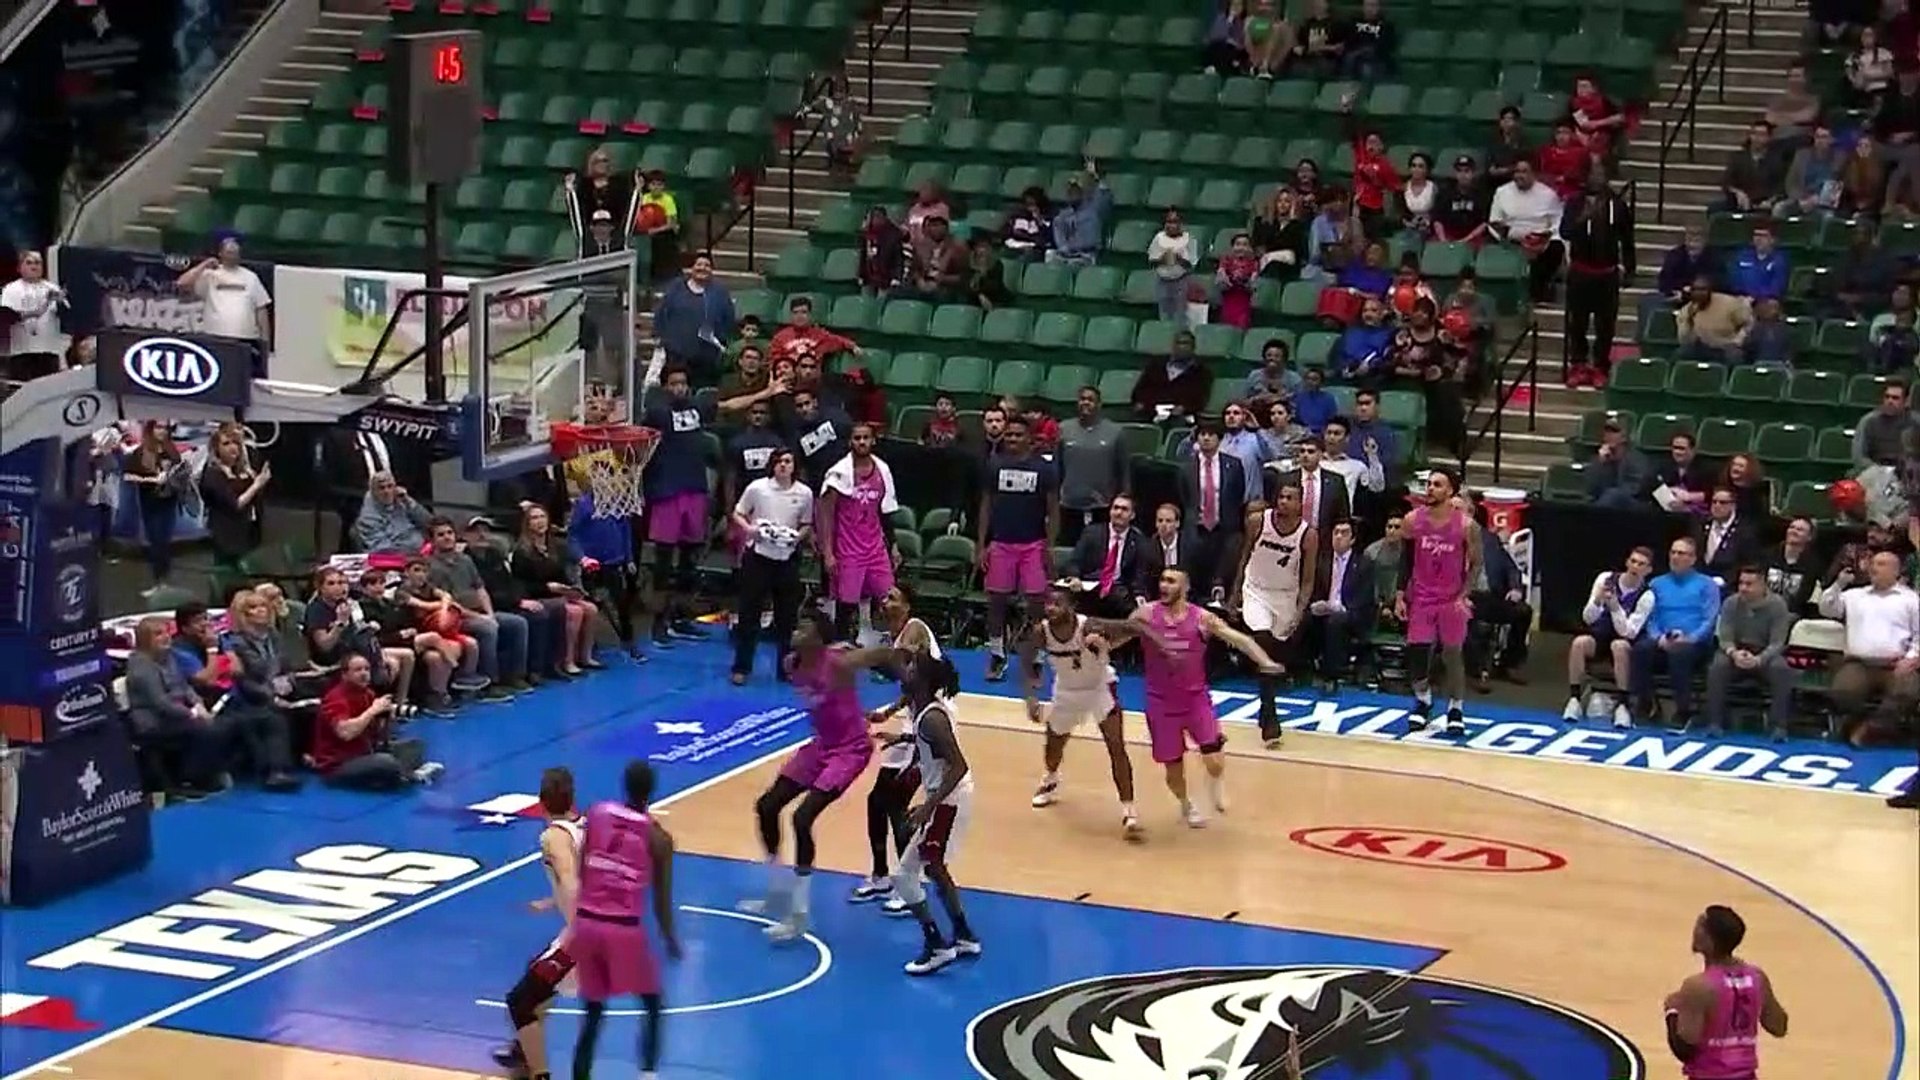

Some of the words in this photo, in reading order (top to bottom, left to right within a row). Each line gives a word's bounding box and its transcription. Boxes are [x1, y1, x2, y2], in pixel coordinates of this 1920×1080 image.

[140, 348, 204, 384] KIA
[359, 414, 439, 441] SWYPIT
[1492, 511, 1508, 528] G
[1276, 554, 1291, 568] 4
[1332, 831, 1507, 868] KIA
[26, 843, 481, 981] TEXAS
